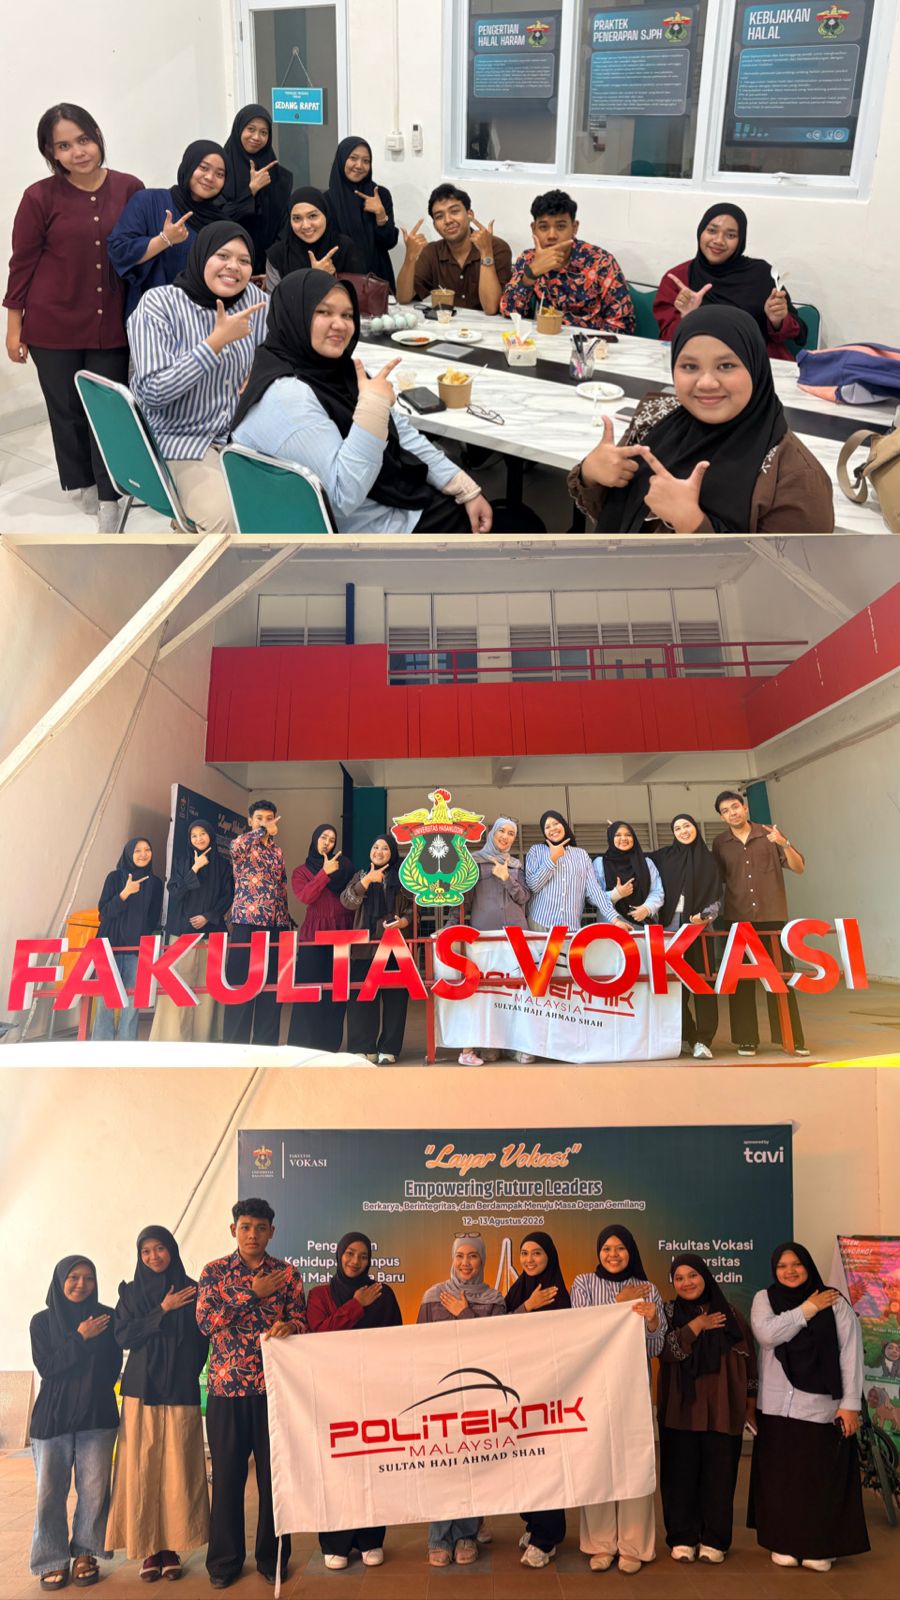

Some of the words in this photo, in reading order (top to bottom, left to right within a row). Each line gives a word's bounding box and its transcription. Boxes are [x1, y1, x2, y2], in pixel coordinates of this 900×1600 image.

[749, 8, 811, 25] KEBIJAKAN
[478, 24, 519, 35] PENGERTIAN
[593, 18, 628, 30] PRAKTEK
[593, 30, 639, 42] PENERAPAN
[641, 28, 663, 40] SJPH
[747, 26, 780, 40] HALAL
[478, 35, 499, 47] HALAL
[500, 34, 525, 46] HARAM
[275, 101, 298, 110] SEDANG
[300, 102, 320, 111] RAPAT
[7, 924, 481, 1011] FAKULTAS
[503, 917, 869, 998] VOKASI
[514, 993, 582, 1015] MALAYSIA
[524, 1007, 543, 1017] HAJI
[545, 1011, 576, 1023] AHMAD
[579, 1018, 603, 1028] SHAH
[743, 1146, 784, 1163] tavi
[289, 1159, 327, 1168] VOKASI
[404, 1178, 495, 1200] Empowering
[495, 1180, 543, 1197] Future
[545, 1177, 603, 1197] Leaders
[363, 1201, 402, 1213] Berkarya,
[403, 1200, 459, 1213] Berintegritas,
[460, 1200, 476, 1211] dan
[476, 1200, 523, 1213] Berdampak
[524, 1200, 554, 1212] Menuju
[555, 1201, 577, 1211] Masa
[577, 1200, 604, 1211] Depan
[605, 1199, 645, 1211] Gemilang
[462, 1216, 472, 1226] 12
[479, 1216, 489, 1226] 13
[489, 1216, 521, 1228] Agustus
[522, 1216, 544, 1226] 2026
[658, 1239, 710, 1251] Fakultas
[712, 1239, 754, 1251] Vokasi
[377, 1271, 405, 1283] Baru
[409, 1436, 515, 1457] MALAYSIA
[379, 1461, 425, 1473] SULTAN
[430, 1458, 458, 1469] HAJI
[463, 1452, 508, 1465] AHMAD
[512, 1447, 546, 1459] SHAH
